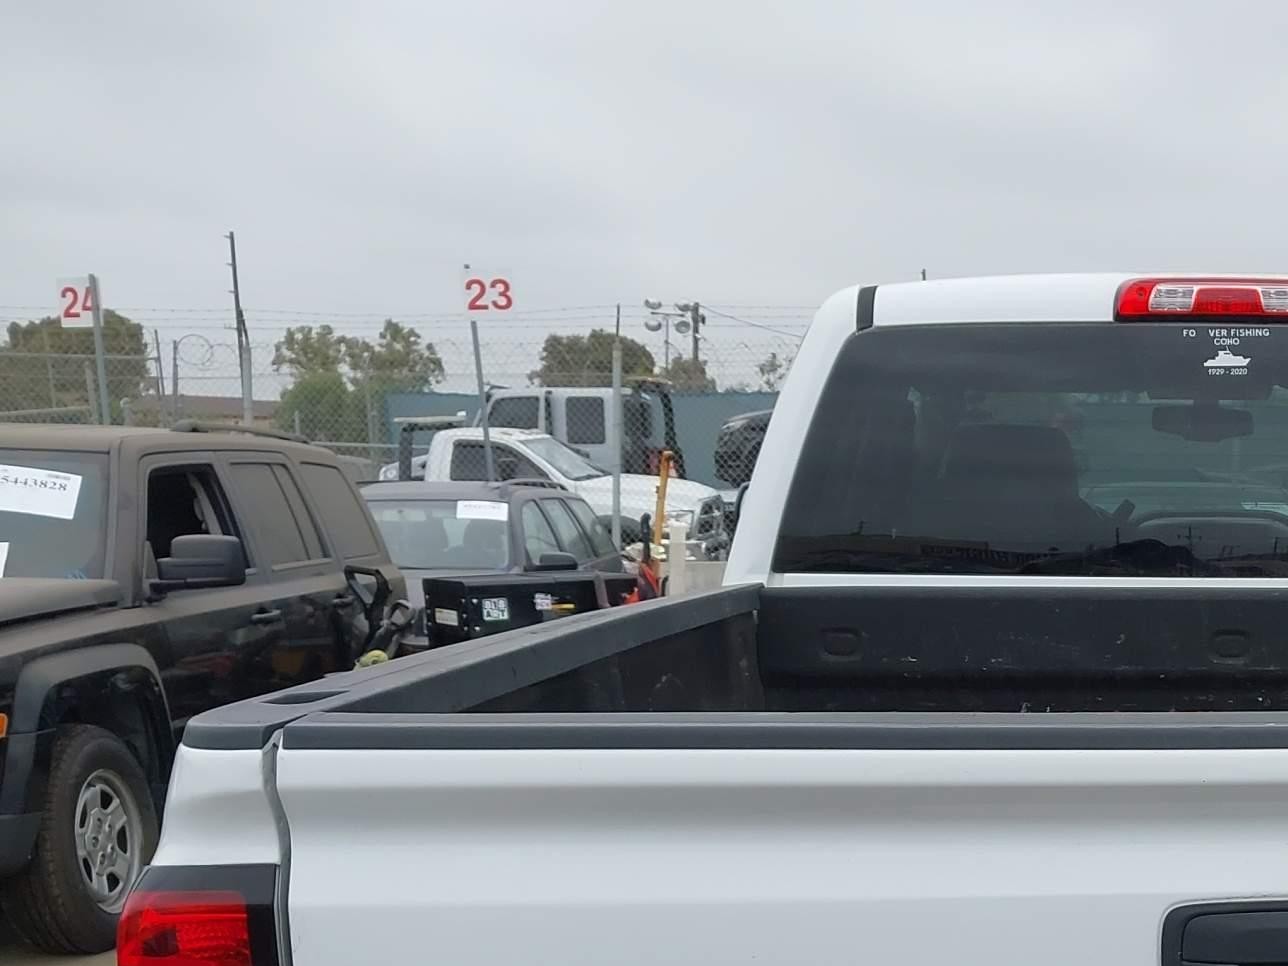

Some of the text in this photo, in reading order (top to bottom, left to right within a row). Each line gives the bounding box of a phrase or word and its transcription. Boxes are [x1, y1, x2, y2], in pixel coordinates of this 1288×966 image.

[61, 286, 95, 318] 24
[465, 279, 512, 310] 23
[1213, 338, 1240, 346] COHO
[1230, 328, 1270, 337] FISHING
